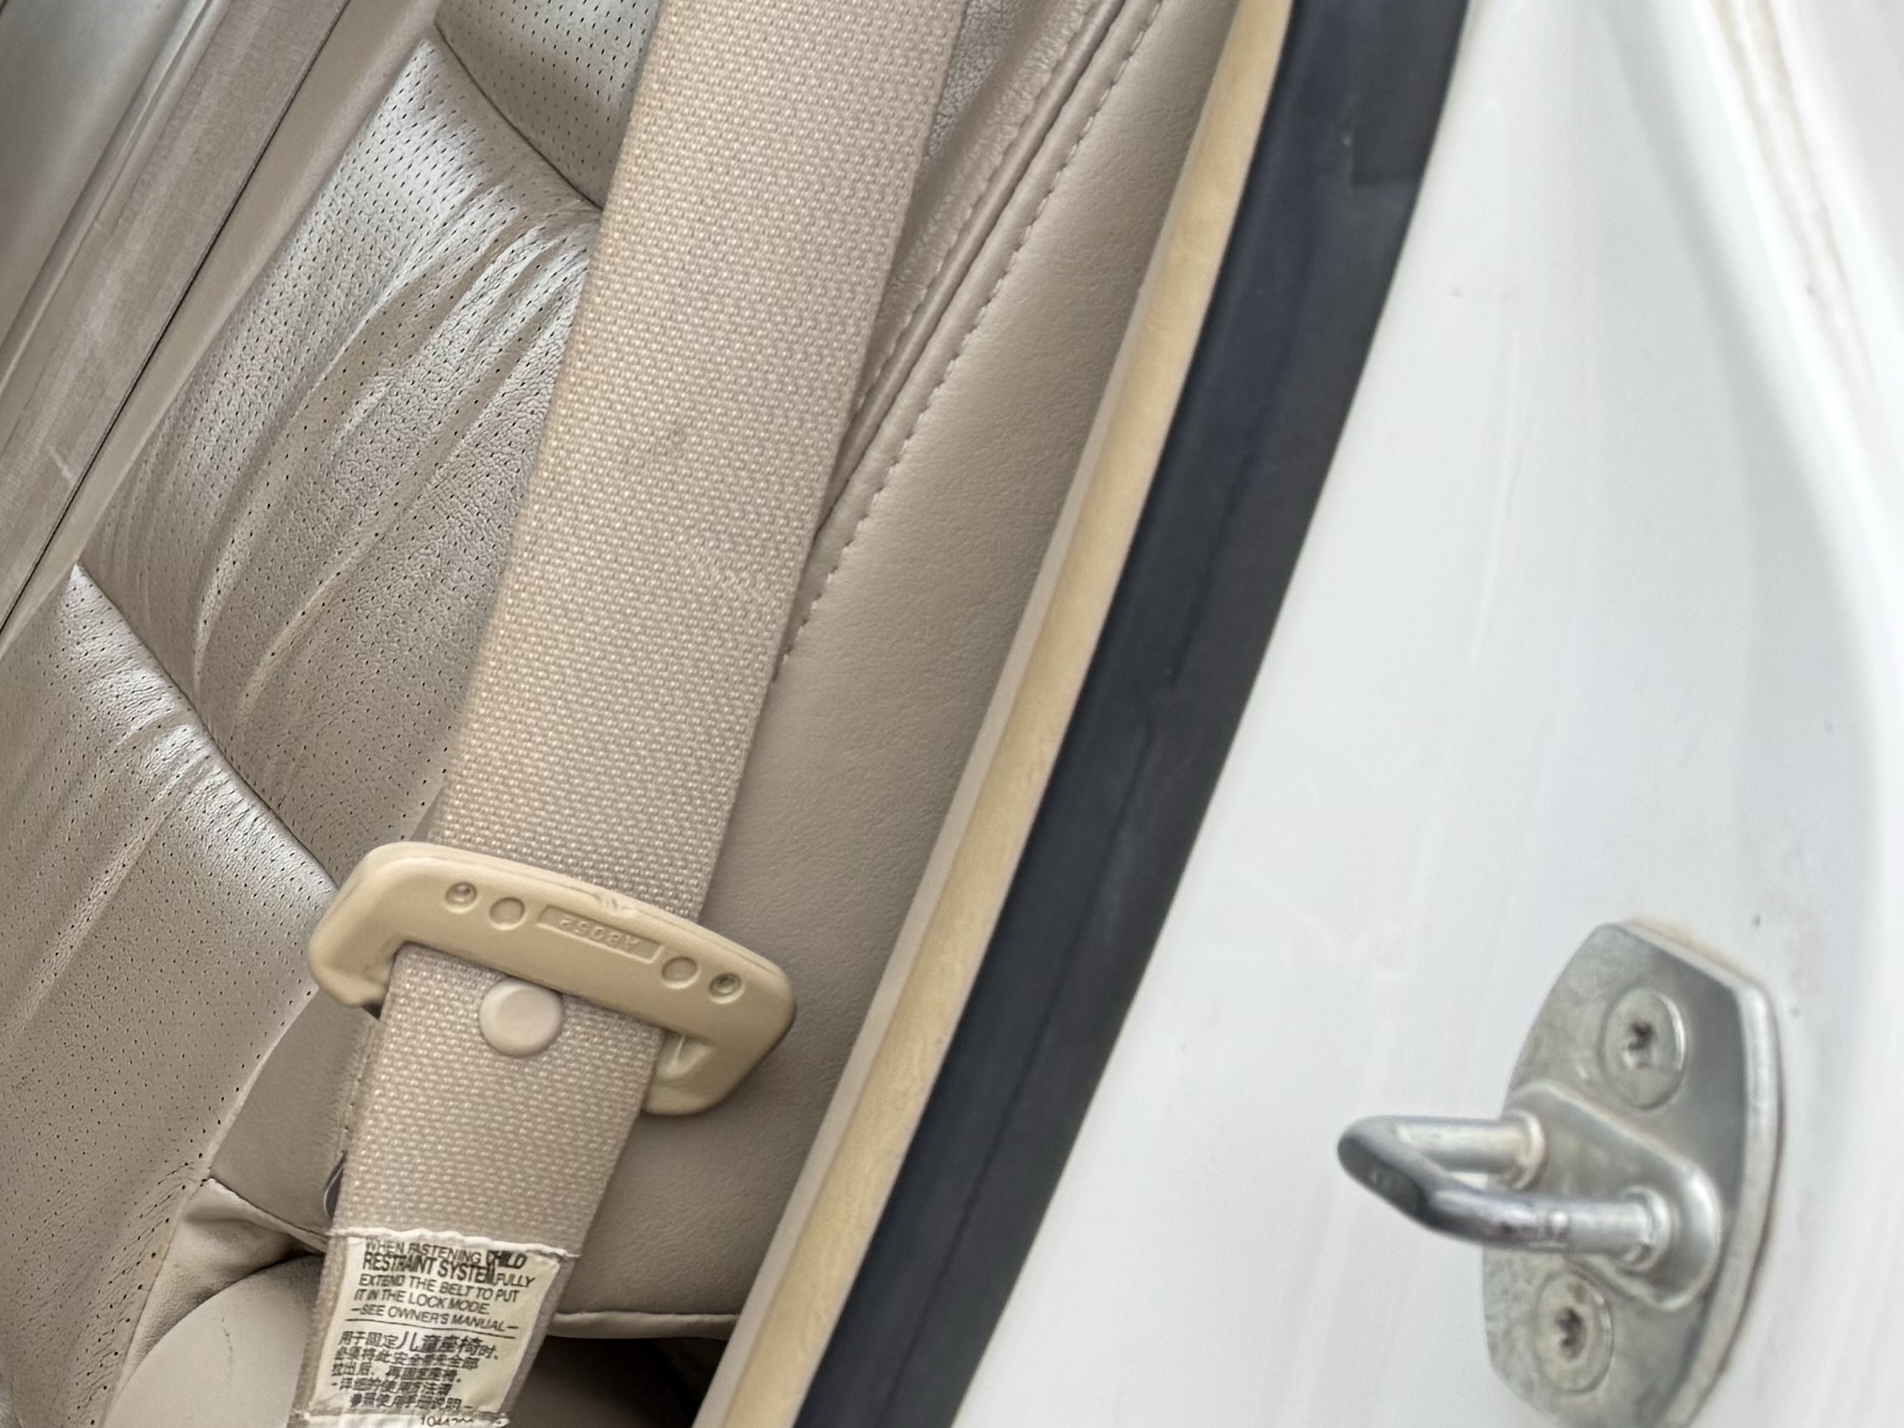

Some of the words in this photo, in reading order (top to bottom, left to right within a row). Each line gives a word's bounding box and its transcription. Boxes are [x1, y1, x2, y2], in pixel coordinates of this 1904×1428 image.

[364, 1239, 405, 1255] WHEN
[407, 1242, 483, 1265] FASTENING
[486, 1249, 528, 1270] CHILD
[363, 1251, 437, 1274] RESTRAINT
[437, 1258, 496, 1286] SYSTEM
[496, 1272, 536, 1289] FULLY
[354, 1288, 366, 1302] IT
[366, 1289, 379, 1302] IN
[380, 1289, 405, 1304] THE
[408, 1292, 445, 1309] LOCK
[358, 1273, 405, 1288] EXTEND
[408, 1275, 437, 1292] THE
[439, 1281, 476, 1297] BELT
[475, 1285, 494, 1301] TO
[494, 1289, 521, 1303] PUT
[387, 1305, 451, 1325] OWNER'S
